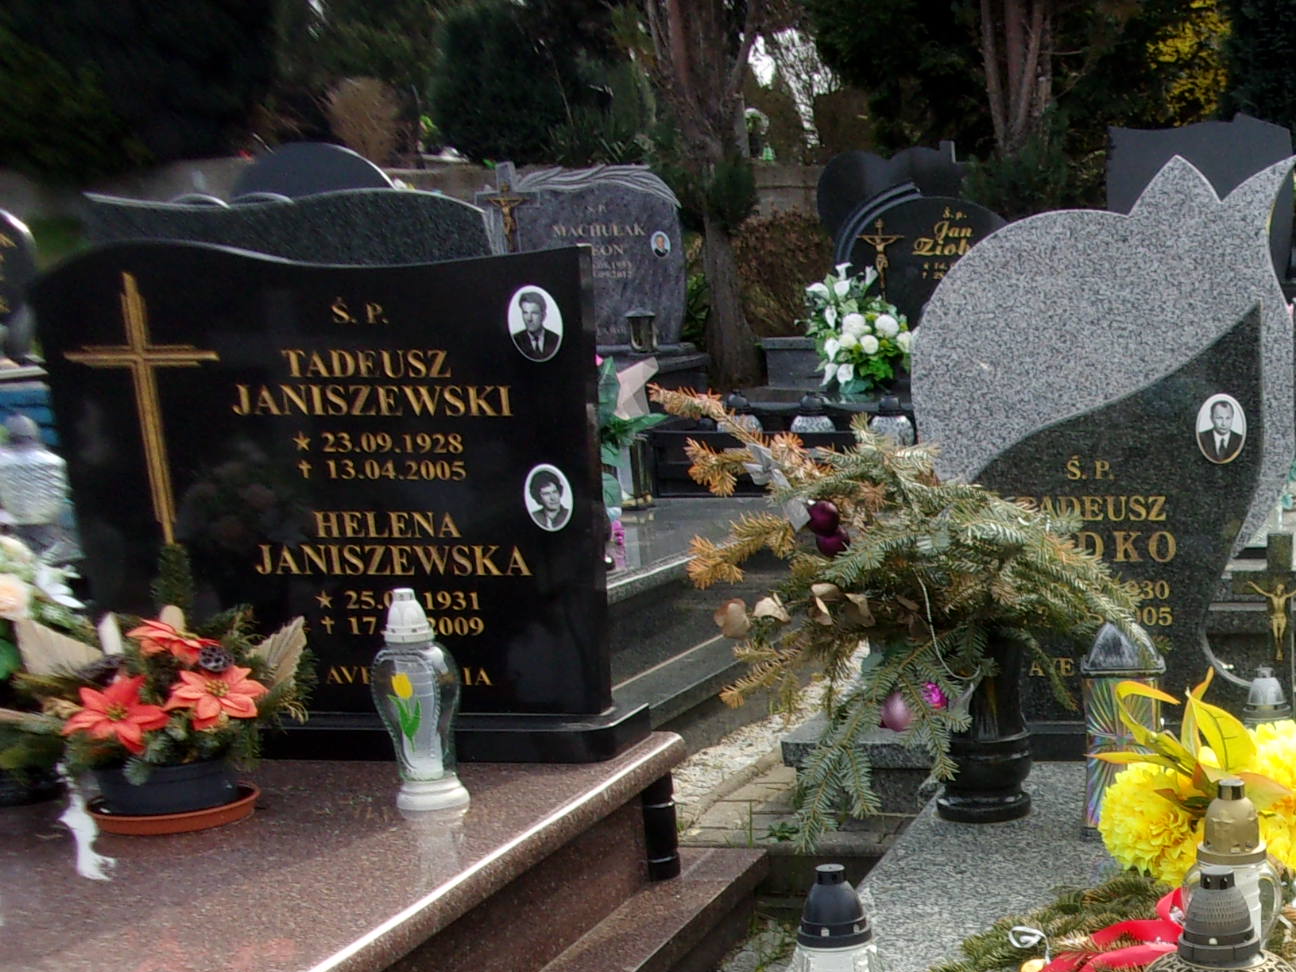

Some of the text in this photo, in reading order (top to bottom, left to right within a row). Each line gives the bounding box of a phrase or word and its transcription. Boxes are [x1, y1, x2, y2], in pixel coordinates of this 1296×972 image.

[934, 221, 973, 245] Jan
[591, 244, 625, 257] EON
[912, 237, 972, 256] Ziob
[330, 297, 390, 325] Ś. P.
[281, 349, 452, 379] TADEUSZ
[232, 384, 514, 418] JANISZEWSKI
[321, 432, 465, 454] 23.09.1928
[325, 459, 468, 481] 13.04.2005
[1066, 456, 1115, 481] Ś. P.
[313, 511, 463, 539] HELENA
[255, 544, 534, 577] JANISZEWSKA
